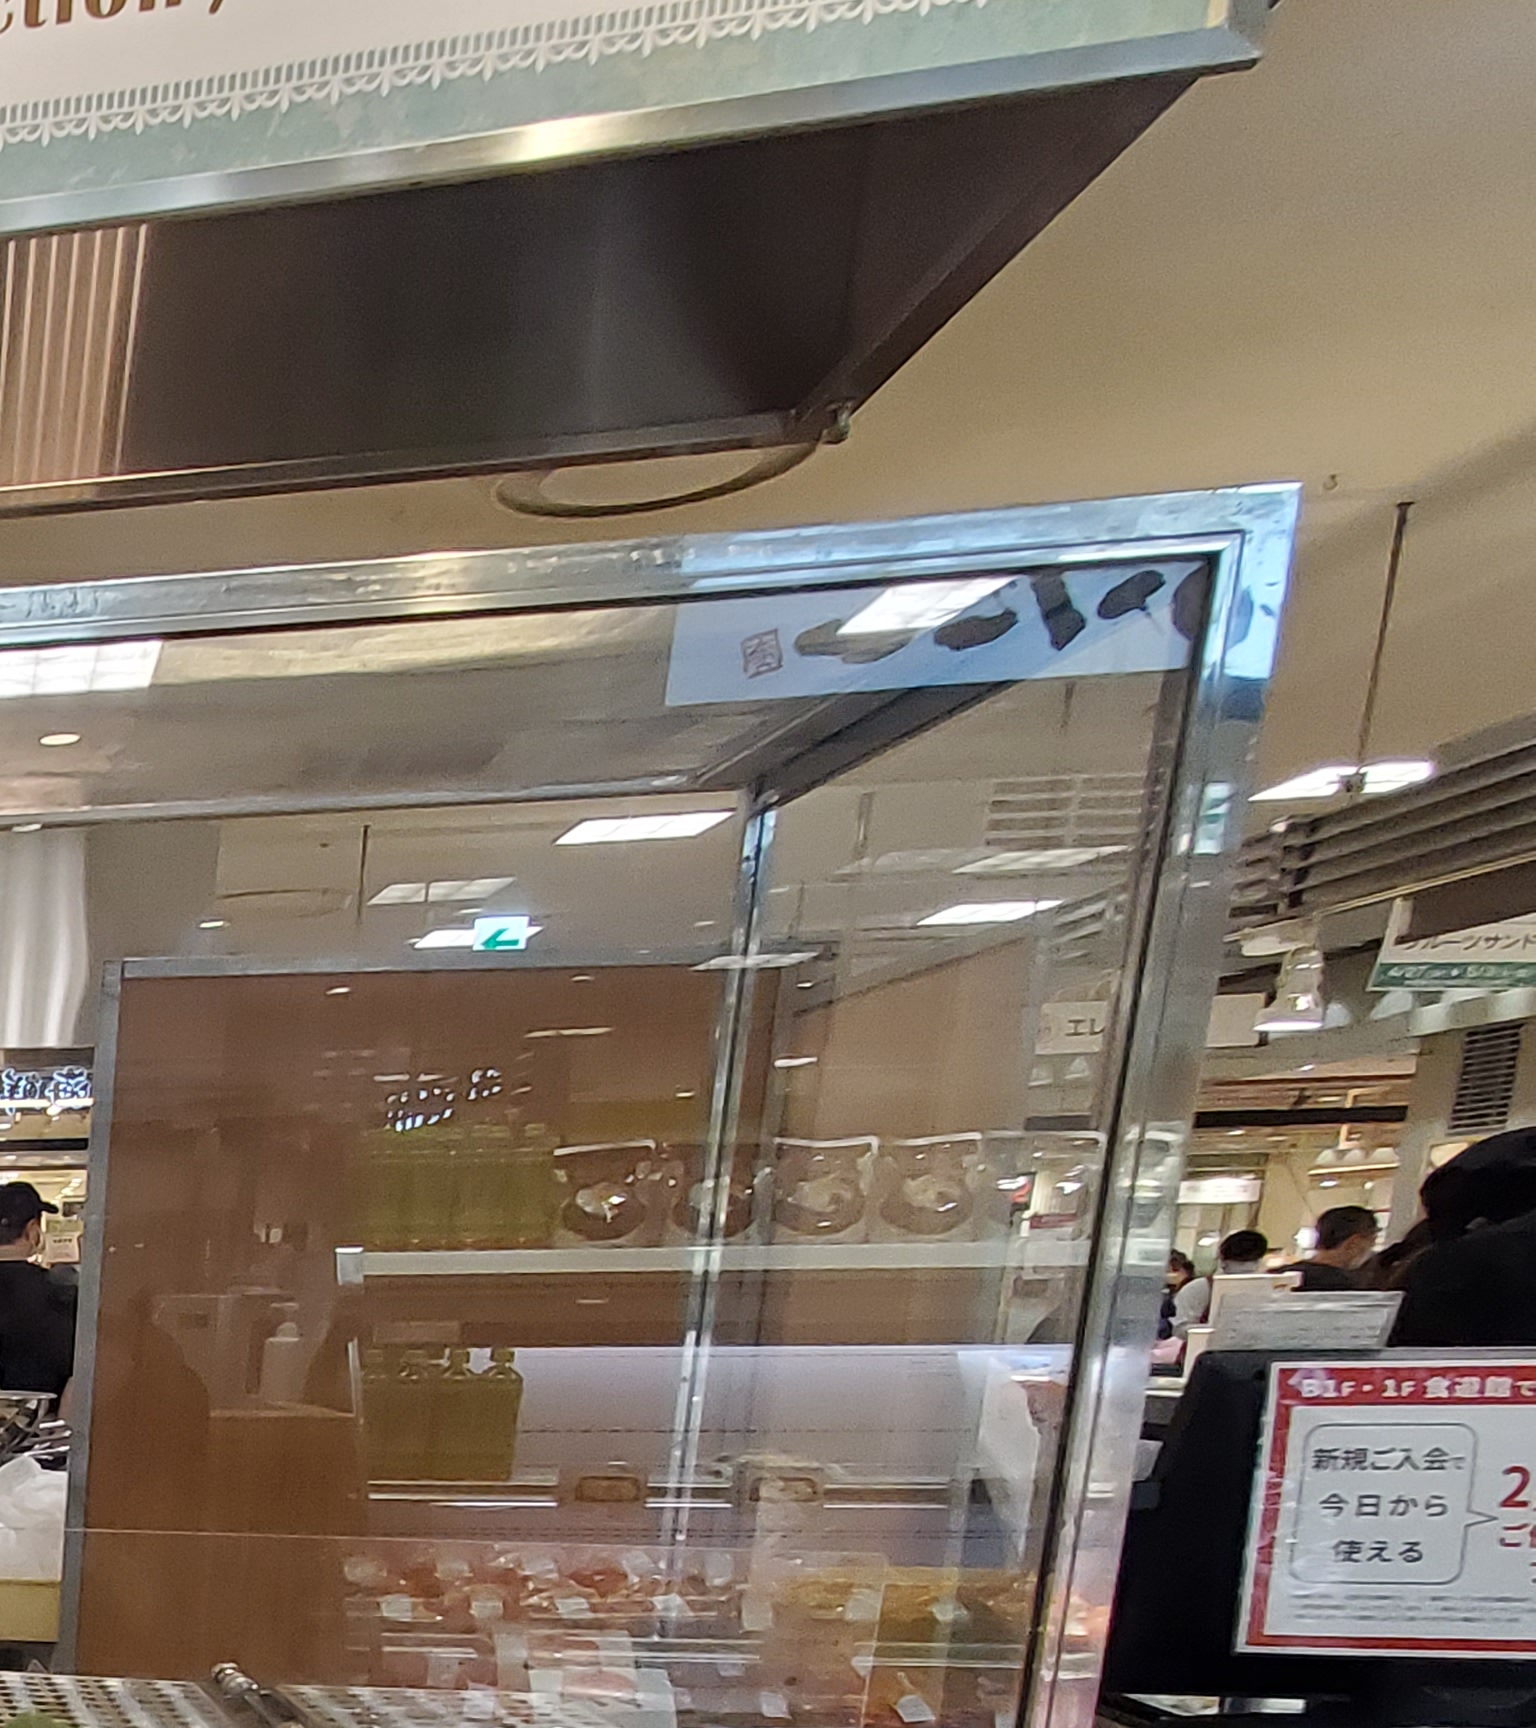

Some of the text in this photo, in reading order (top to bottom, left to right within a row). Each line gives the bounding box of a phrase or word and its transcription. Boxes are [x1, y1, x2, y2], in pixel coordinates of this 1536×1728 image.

[1318, 1493, 1449, 1518] 今日から
[1331, 1540, 1424, 1563] 使える
